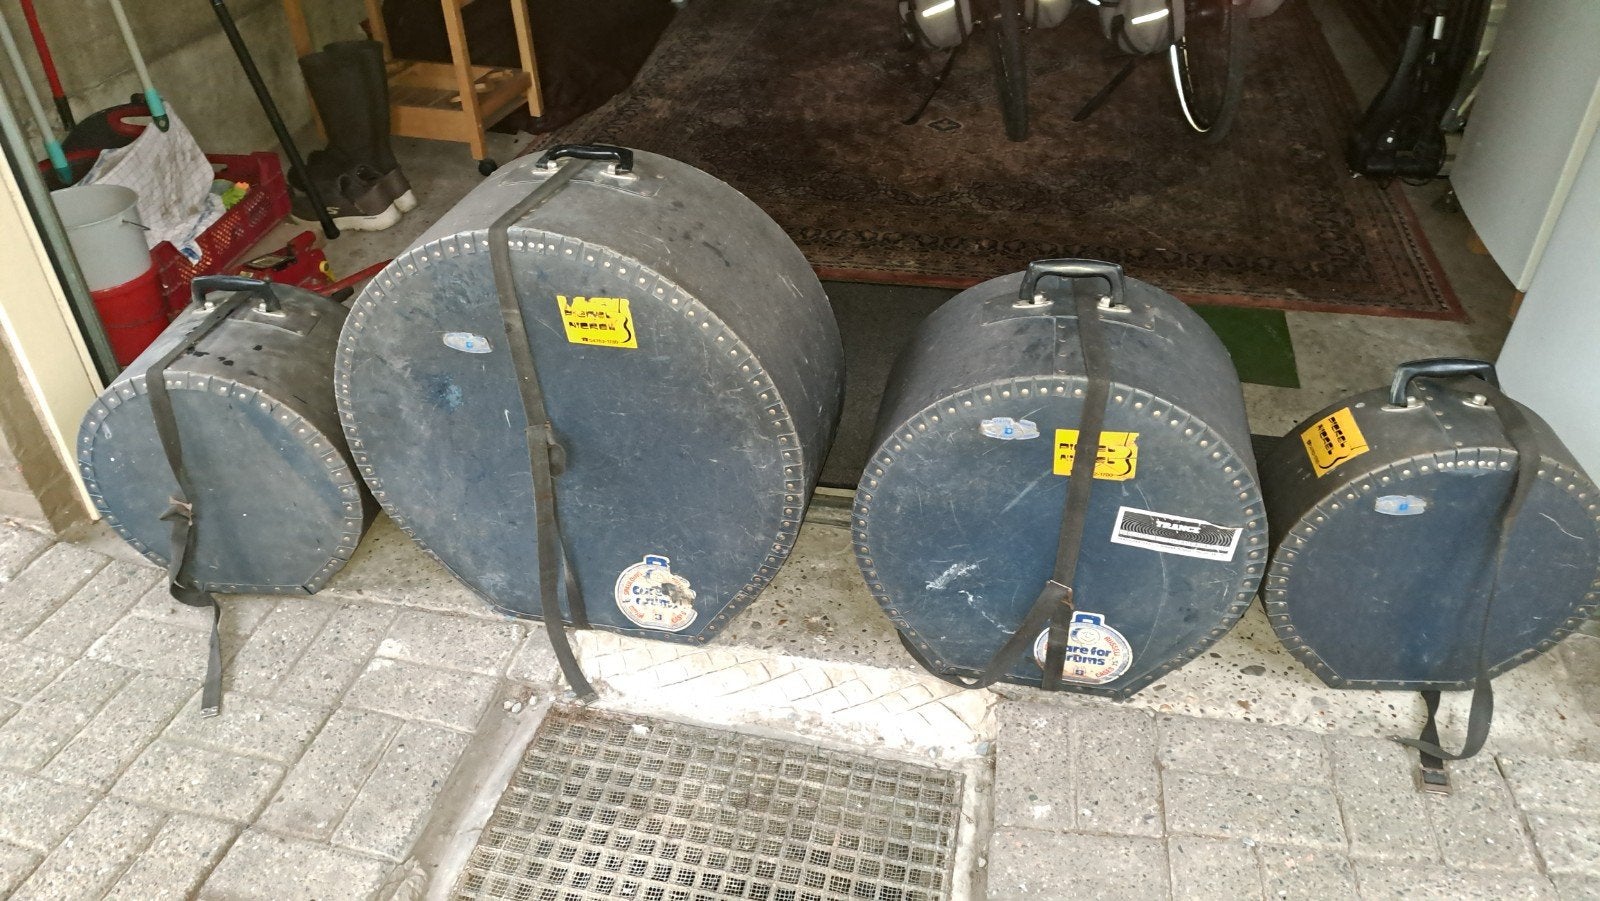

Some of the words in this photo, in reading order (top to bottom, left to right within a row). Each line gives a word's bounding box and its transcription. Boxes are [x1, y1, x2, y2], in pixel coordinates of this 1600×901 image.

[1065, 645, 1089, 655] are
[1090, 646, 1112, 657] for
[1066, 654, 1106, 666] rums
